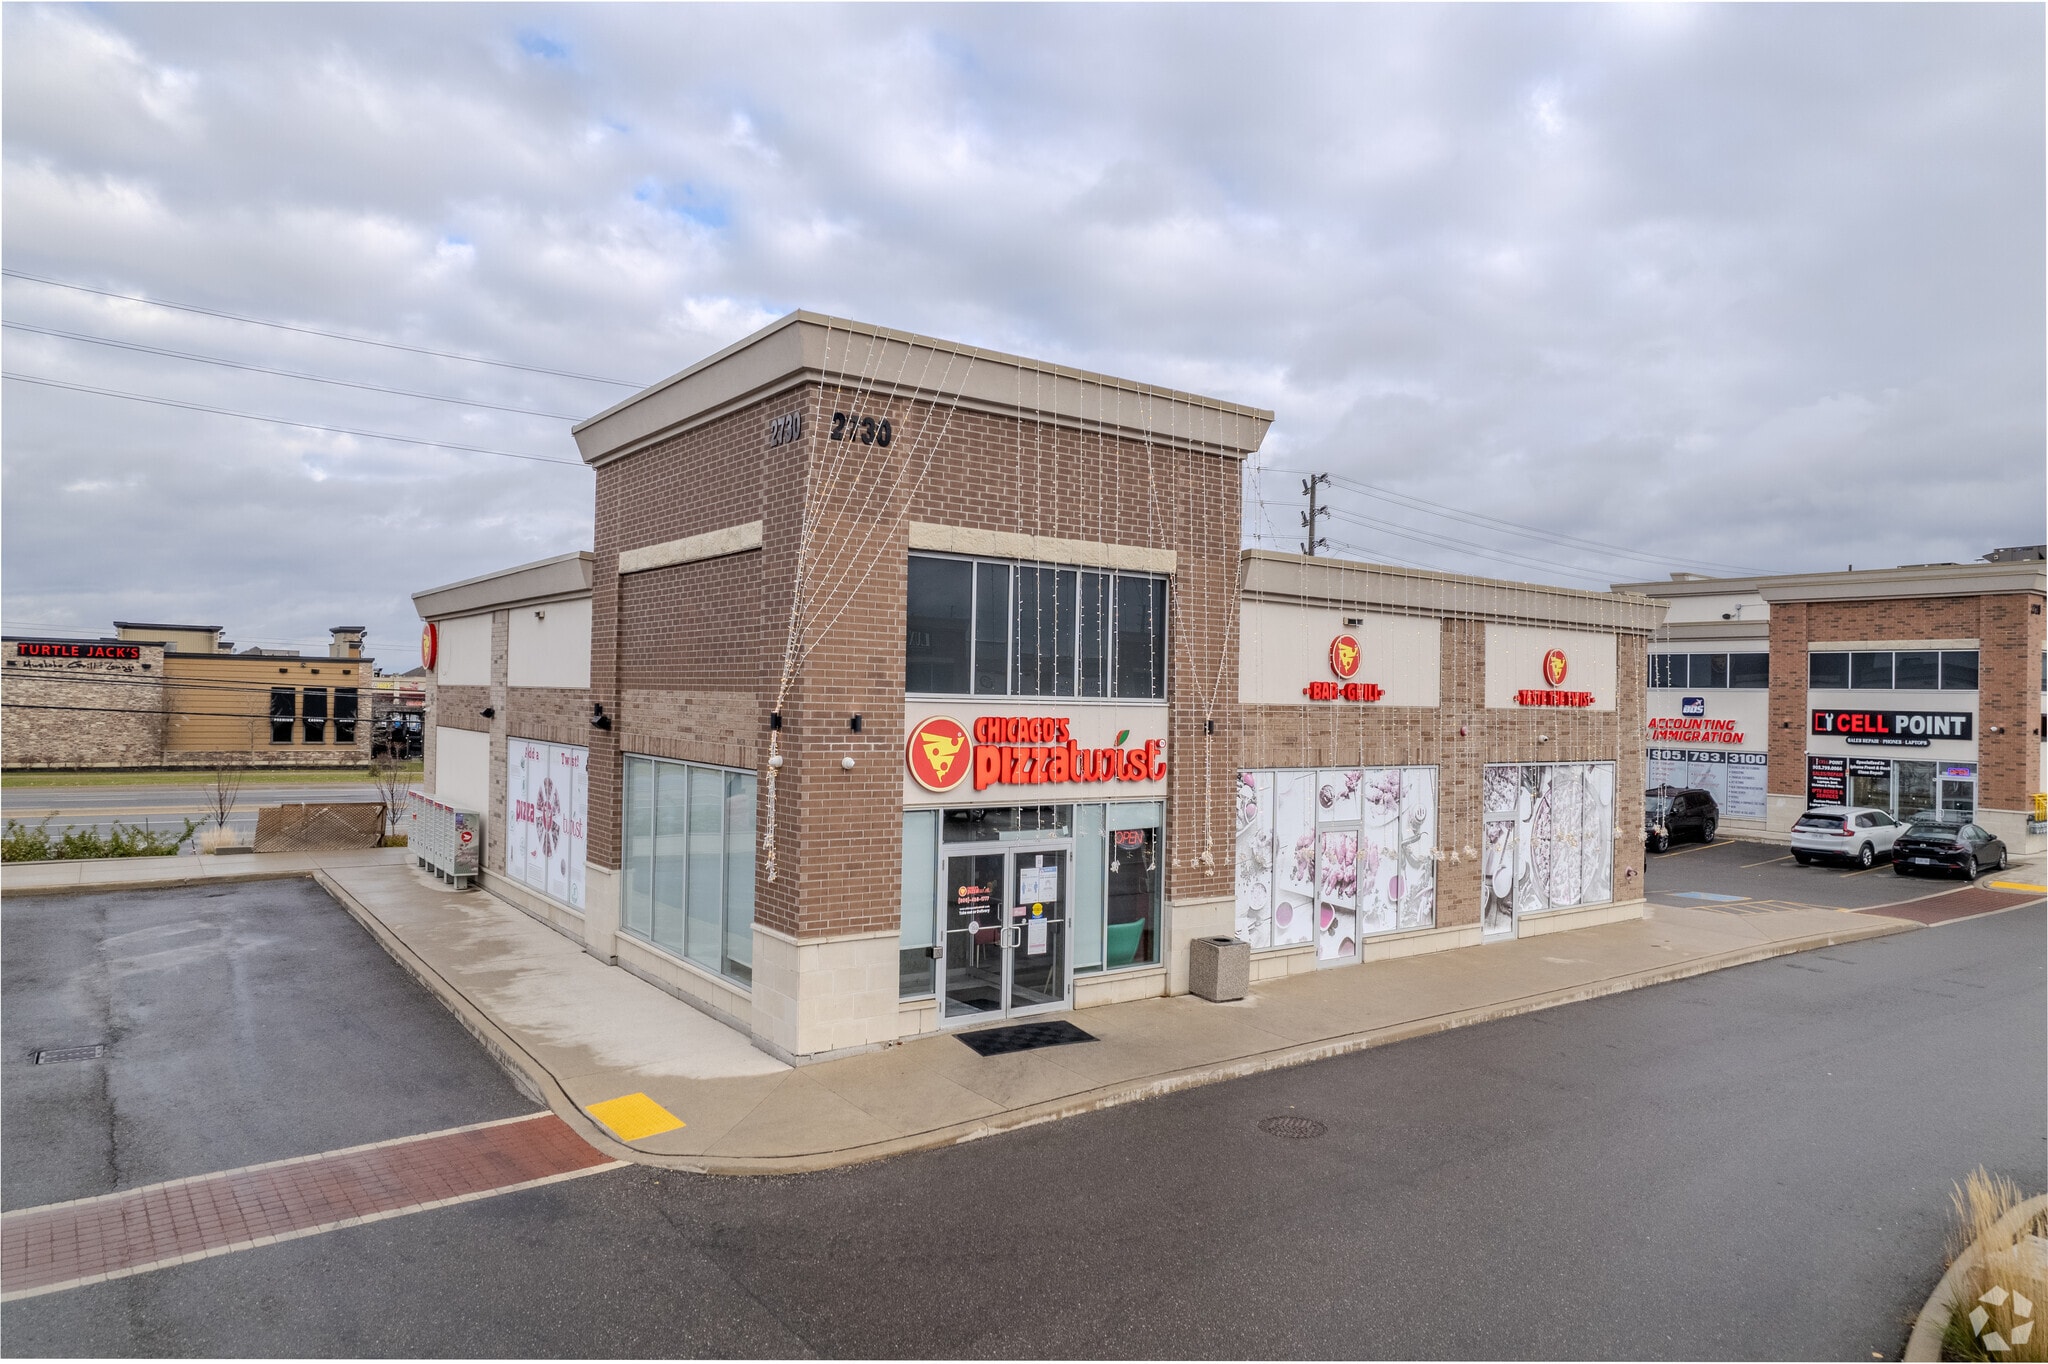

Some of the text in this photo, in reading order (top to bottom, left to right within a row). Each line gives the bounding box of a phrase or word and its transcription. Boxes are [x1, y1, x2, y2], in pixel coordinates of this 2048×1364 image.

[771, 411, 801, 448] 2730
[831, 412, 892, 447] 2730
[18, 644, 139, 658] TURTLE JACK'S
[1309, 681, 1339, 701] BAR
[1343, 682, 1381, 702] GRILL
[1518, 690, 1547, 706] TASTE
[1548, 691, 1565, 707] THE
[974, 716, 1070, 743] CHICAGO'S
[1648, 718, 1736, 731] ACCOUNTING
[1836, 713, 1966, 736] CELL POINT
[1652, 730, 1745, 744] IMMIGRATION
[561, 752, 580, 767] Twst!
[1652, 750, 1766, 764] 905. 793. 3100
[516, 800, 535, 822] pizza
[1115, 831, 1144, 845] OPEN
